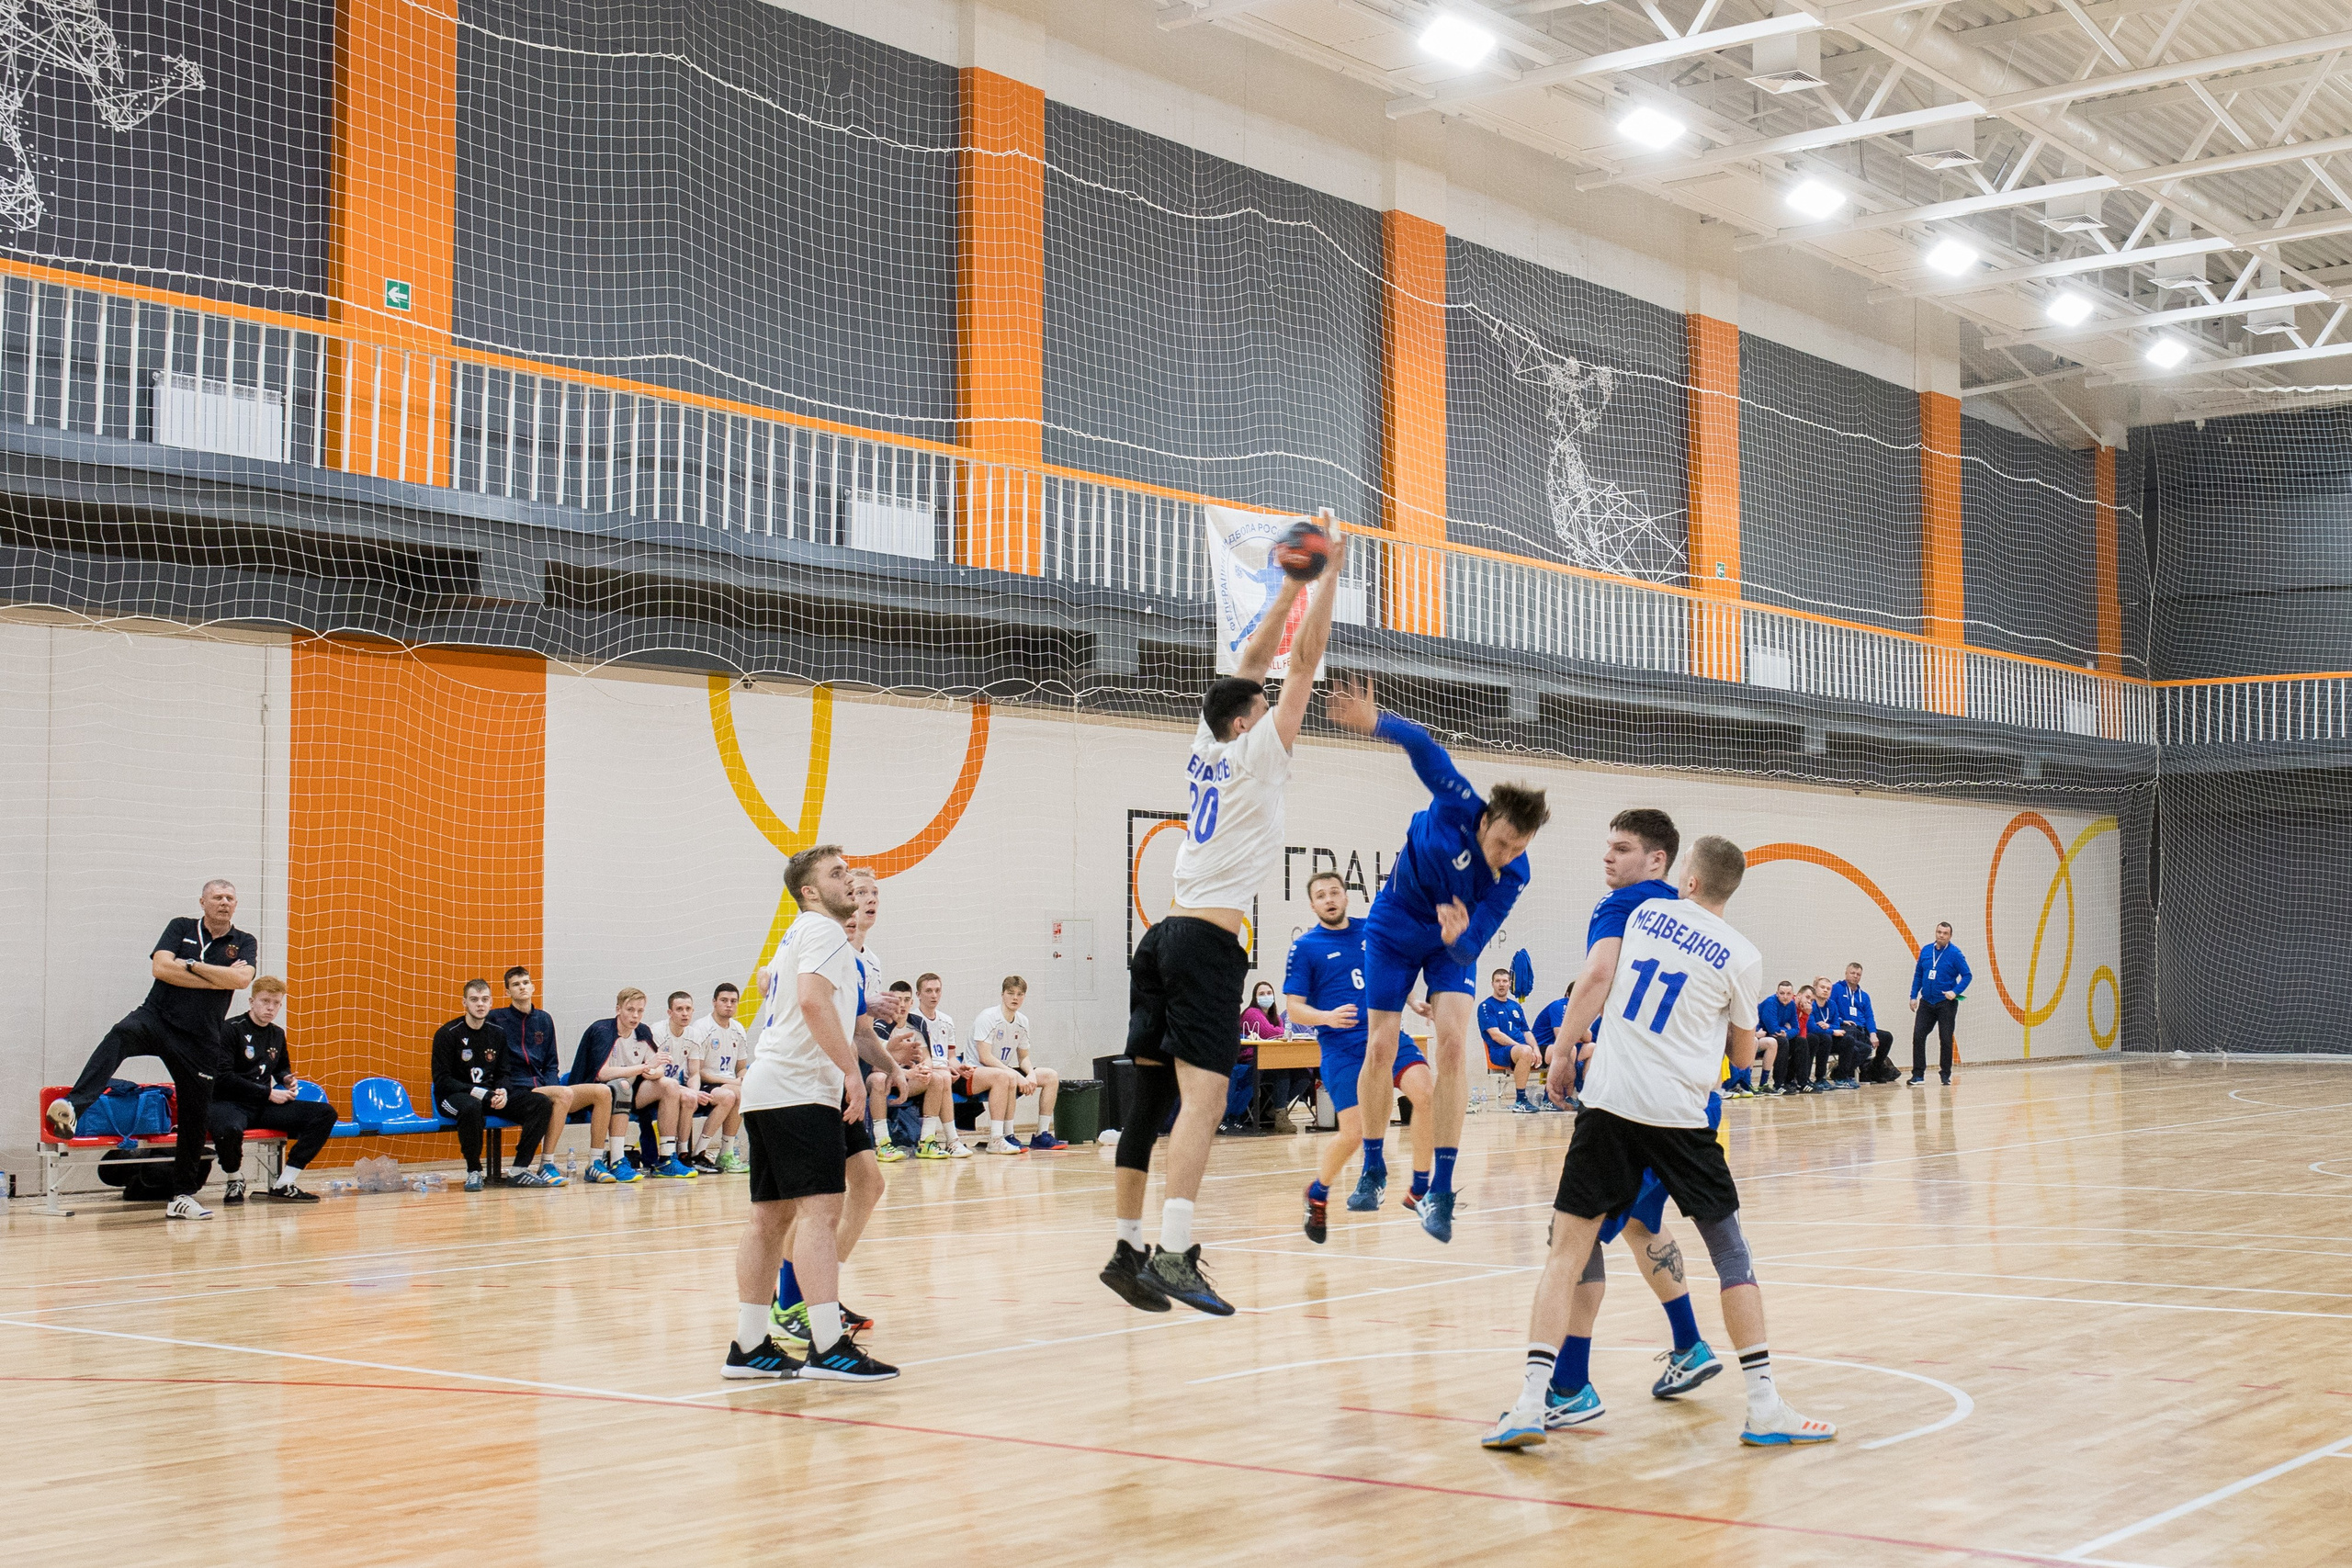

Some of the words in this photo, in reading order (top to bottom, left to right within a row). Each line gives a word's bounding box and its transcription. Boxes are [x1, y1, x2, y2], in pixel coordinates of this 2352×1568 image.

[1452, 849, 1472, 871] 9
[1284, 846, 1401, 903] ГРАН
[1632, 909, 1731, 970] МЕДВЕДКОВ
[1351, 968, 1365, 990] 6
[1623, 958, 1689, 1035] 11
[933, 1043, 944, 1057] 19
[1001, 1046, 1012, 1061] 17
[663, 1064, 680, 1078] 38
[719, 1055, 731, 1071] 27
[470, 1066, 484, 1084] 12
